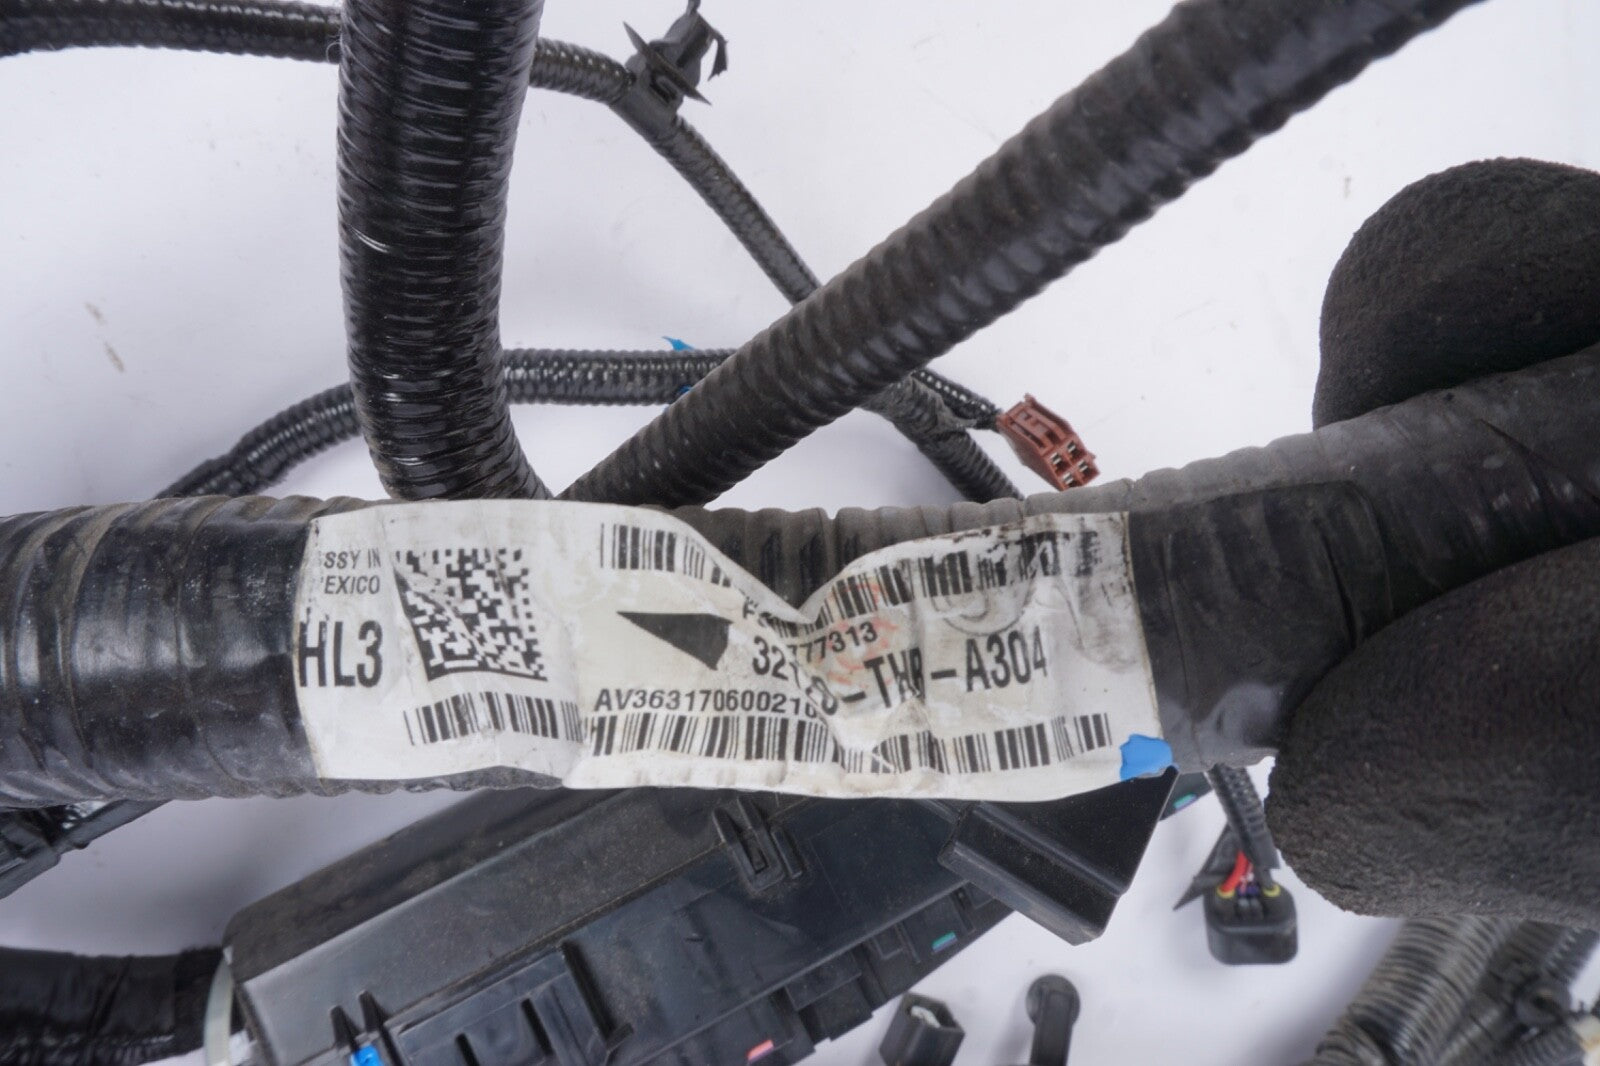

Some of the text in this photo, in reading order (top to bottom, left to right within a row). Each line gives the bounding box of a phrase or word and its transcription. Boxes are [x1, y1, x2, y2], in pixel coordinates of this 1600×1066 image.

[319, 547, 381, 569] SSY IN
[320, 574, 380, 595] EXICO
[299, 620, 383, 687] HL3
